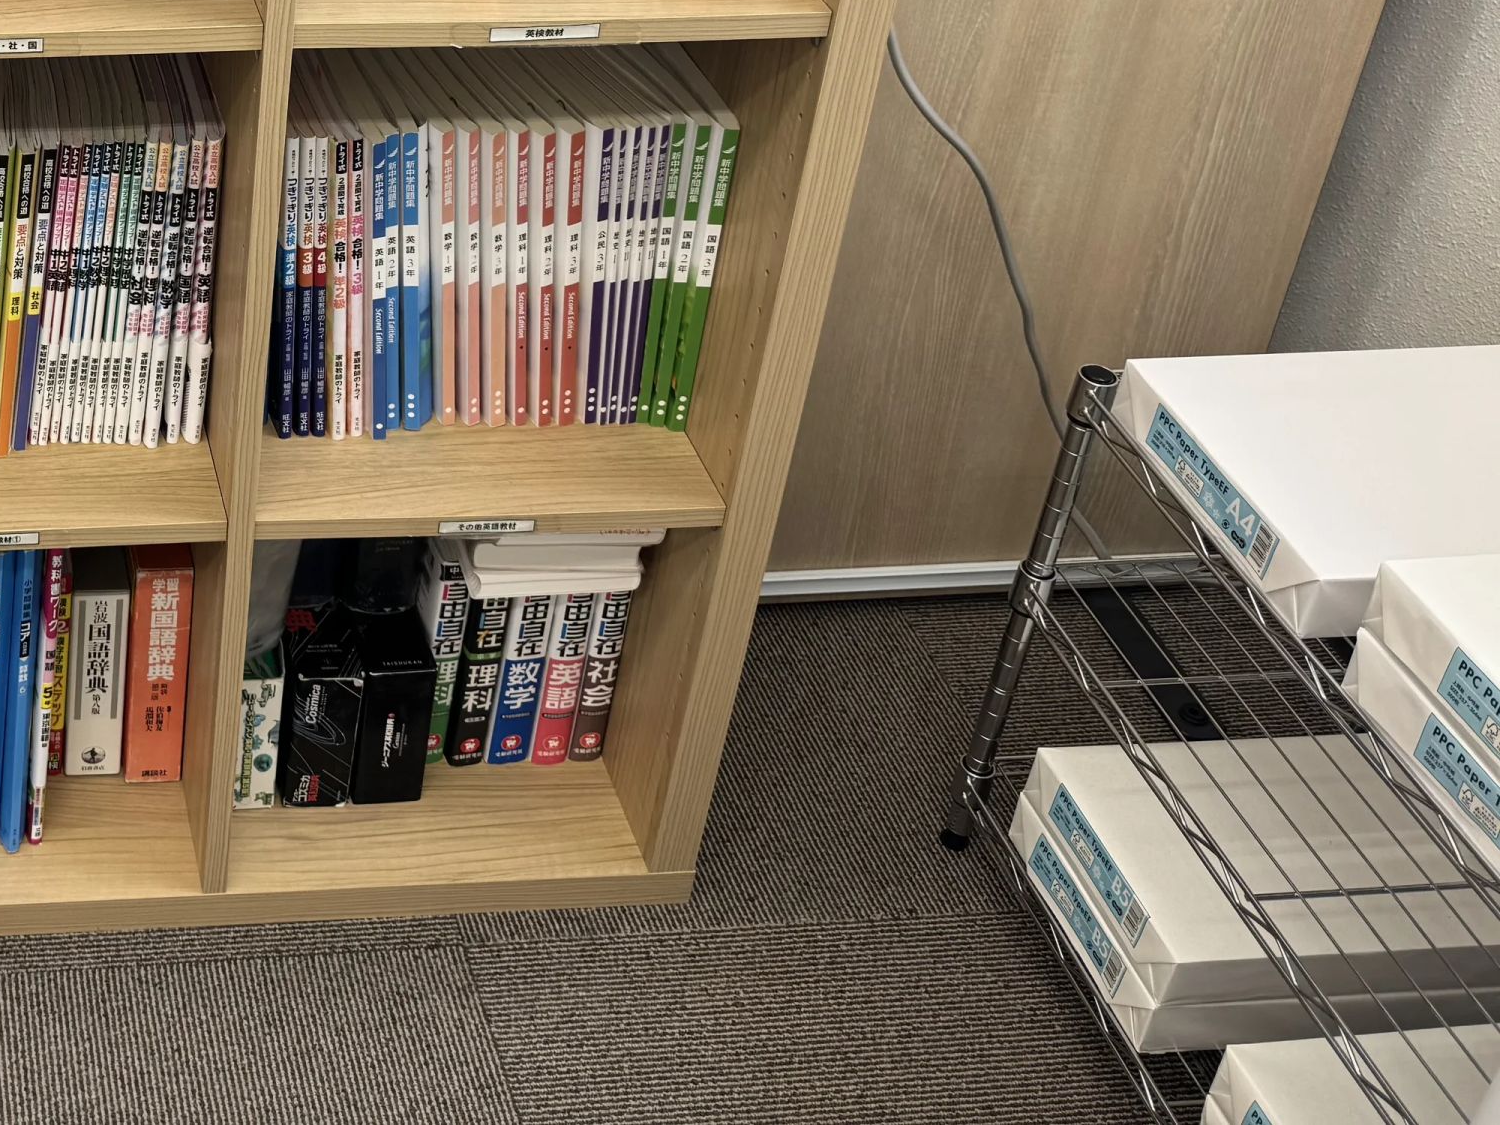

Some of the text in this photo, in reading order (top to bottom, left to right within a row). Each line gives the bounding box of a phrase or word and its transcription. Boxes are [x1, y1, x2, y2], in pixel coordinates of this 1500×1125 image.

[525, 26, 565, 39] 英検教材
[404, 160, 416, 208] 新中学問題集
[715, 158, 732, 206] 新中学問題集
[285, 177, 297, 247] つきっきり英検
[302, 252, 313, 275] 3級
[316, 252, 327, 275] 4級
[705, 234, 717, 254] 国語
[284, 253, 295, 287] 準2級
[10, 296, 20, 316] 理科
[30, 290, 40, 310] 社会
[1159, 412, 1229, 495] PPC Paper TypeEF
[458, 523, 517, 531] その他英語教材
[1225, 497, 1255, 537] A4
[147, 593, 180, 682] 新国語辞典
[462, 663, 498, 713] 理科
[504, 662, 540, 710] 数学
[545, 663, 583, 709] 英語
[582, 661, 619, 707] 社会
[306, 685, 321, 724] Cosmica
[1433, 726, 1491, 795] PPC Paper
[1112, 875, 1129, 907] B5
